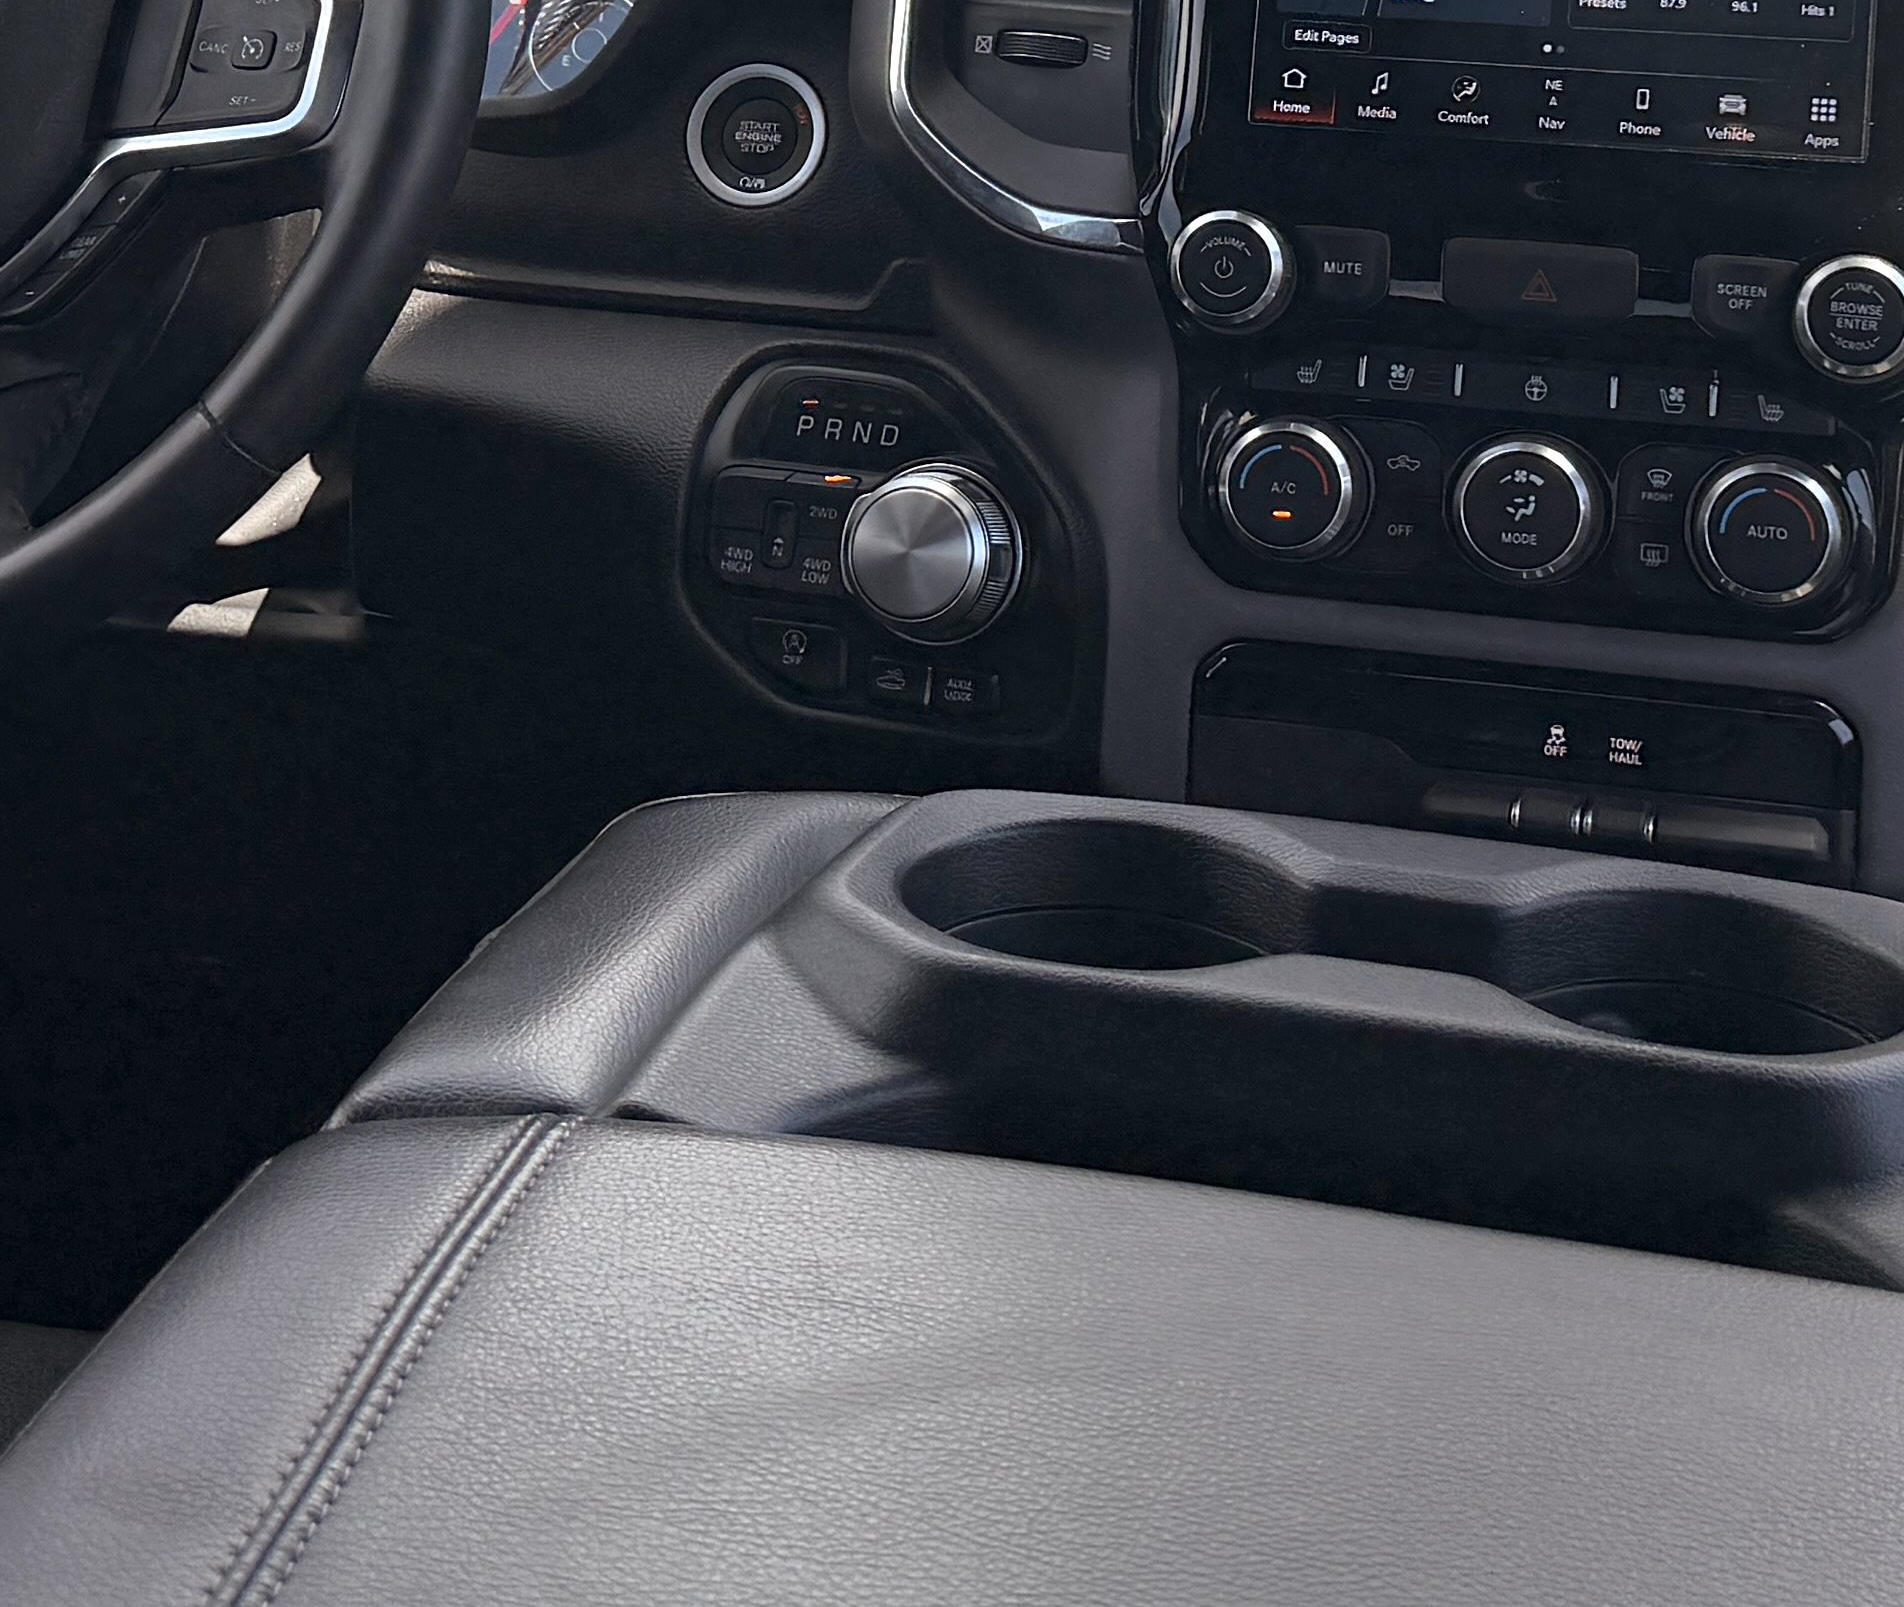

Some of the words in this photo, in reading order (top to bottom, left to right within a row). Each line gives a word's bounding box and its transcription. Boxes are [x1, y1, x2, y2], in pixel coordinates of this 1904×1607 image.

[1731, 1, 1759, 13] 96.1
[1294, 29, 1319, 43] Edit
[1321, 31, 1359, 46] Pages
[561, 54, 572, 68] E
[1545, 79, 1563, 91] NE
[1272, 99, 1311, 114] Home
[1357, 105, 1397, 119] Media
[1437, 111, 1489, 126] Comfort
[1539, 116, 1566, 130] Nav
[740, 120, 781, 133] START
[1619, 121, 1662, 137] Phone
[735, 131, 782, 143] ENGINE
[1705, 126, 1756, 142] Vehicle
[1804, 133, 1840, 149] Apps
[740, 143, 775, 153] STOP
[1205, 236, 1246, 251] VOLUME
[1323, 261, 1363, 276] MUTE
[1717, 282, 1768, 298] SCREEN
[1845, 282, 1874, 294] TUNE
[1728, 298, 1753, 311] OFF
[1830, 301, 1883, 317] BROWSE
[1836, 318, 1878, 332] ENTER
[1834, 337, 1875, 351] SCROLL
[797, 415, 815, 436] P
[825, 418, 843, 440] R
[852, 421, 873, 444] N
[880, 424, 899, 446] D
[1271, 481, 1296, 494] A/C
[1641, 491, 1673, 502] FRONT
[809, 505, 838, 520] 2WD
[1387, 524, 1413, 536] OFF
[1747, 525, 1788, 540] AUTO
[1501, 532, 1537, 545] MODE
[772, 546, 783, 557] N
[720, 559, 753, 574] HIGH
[802, 557, 832, 572] 4WD
[801, 571, 831, 585] LOW
[1543, 744, 1568, 757] OFF
[1609, 737, 1643, 753] TOW/
[1609, 751, 1643, 766] HAUL
